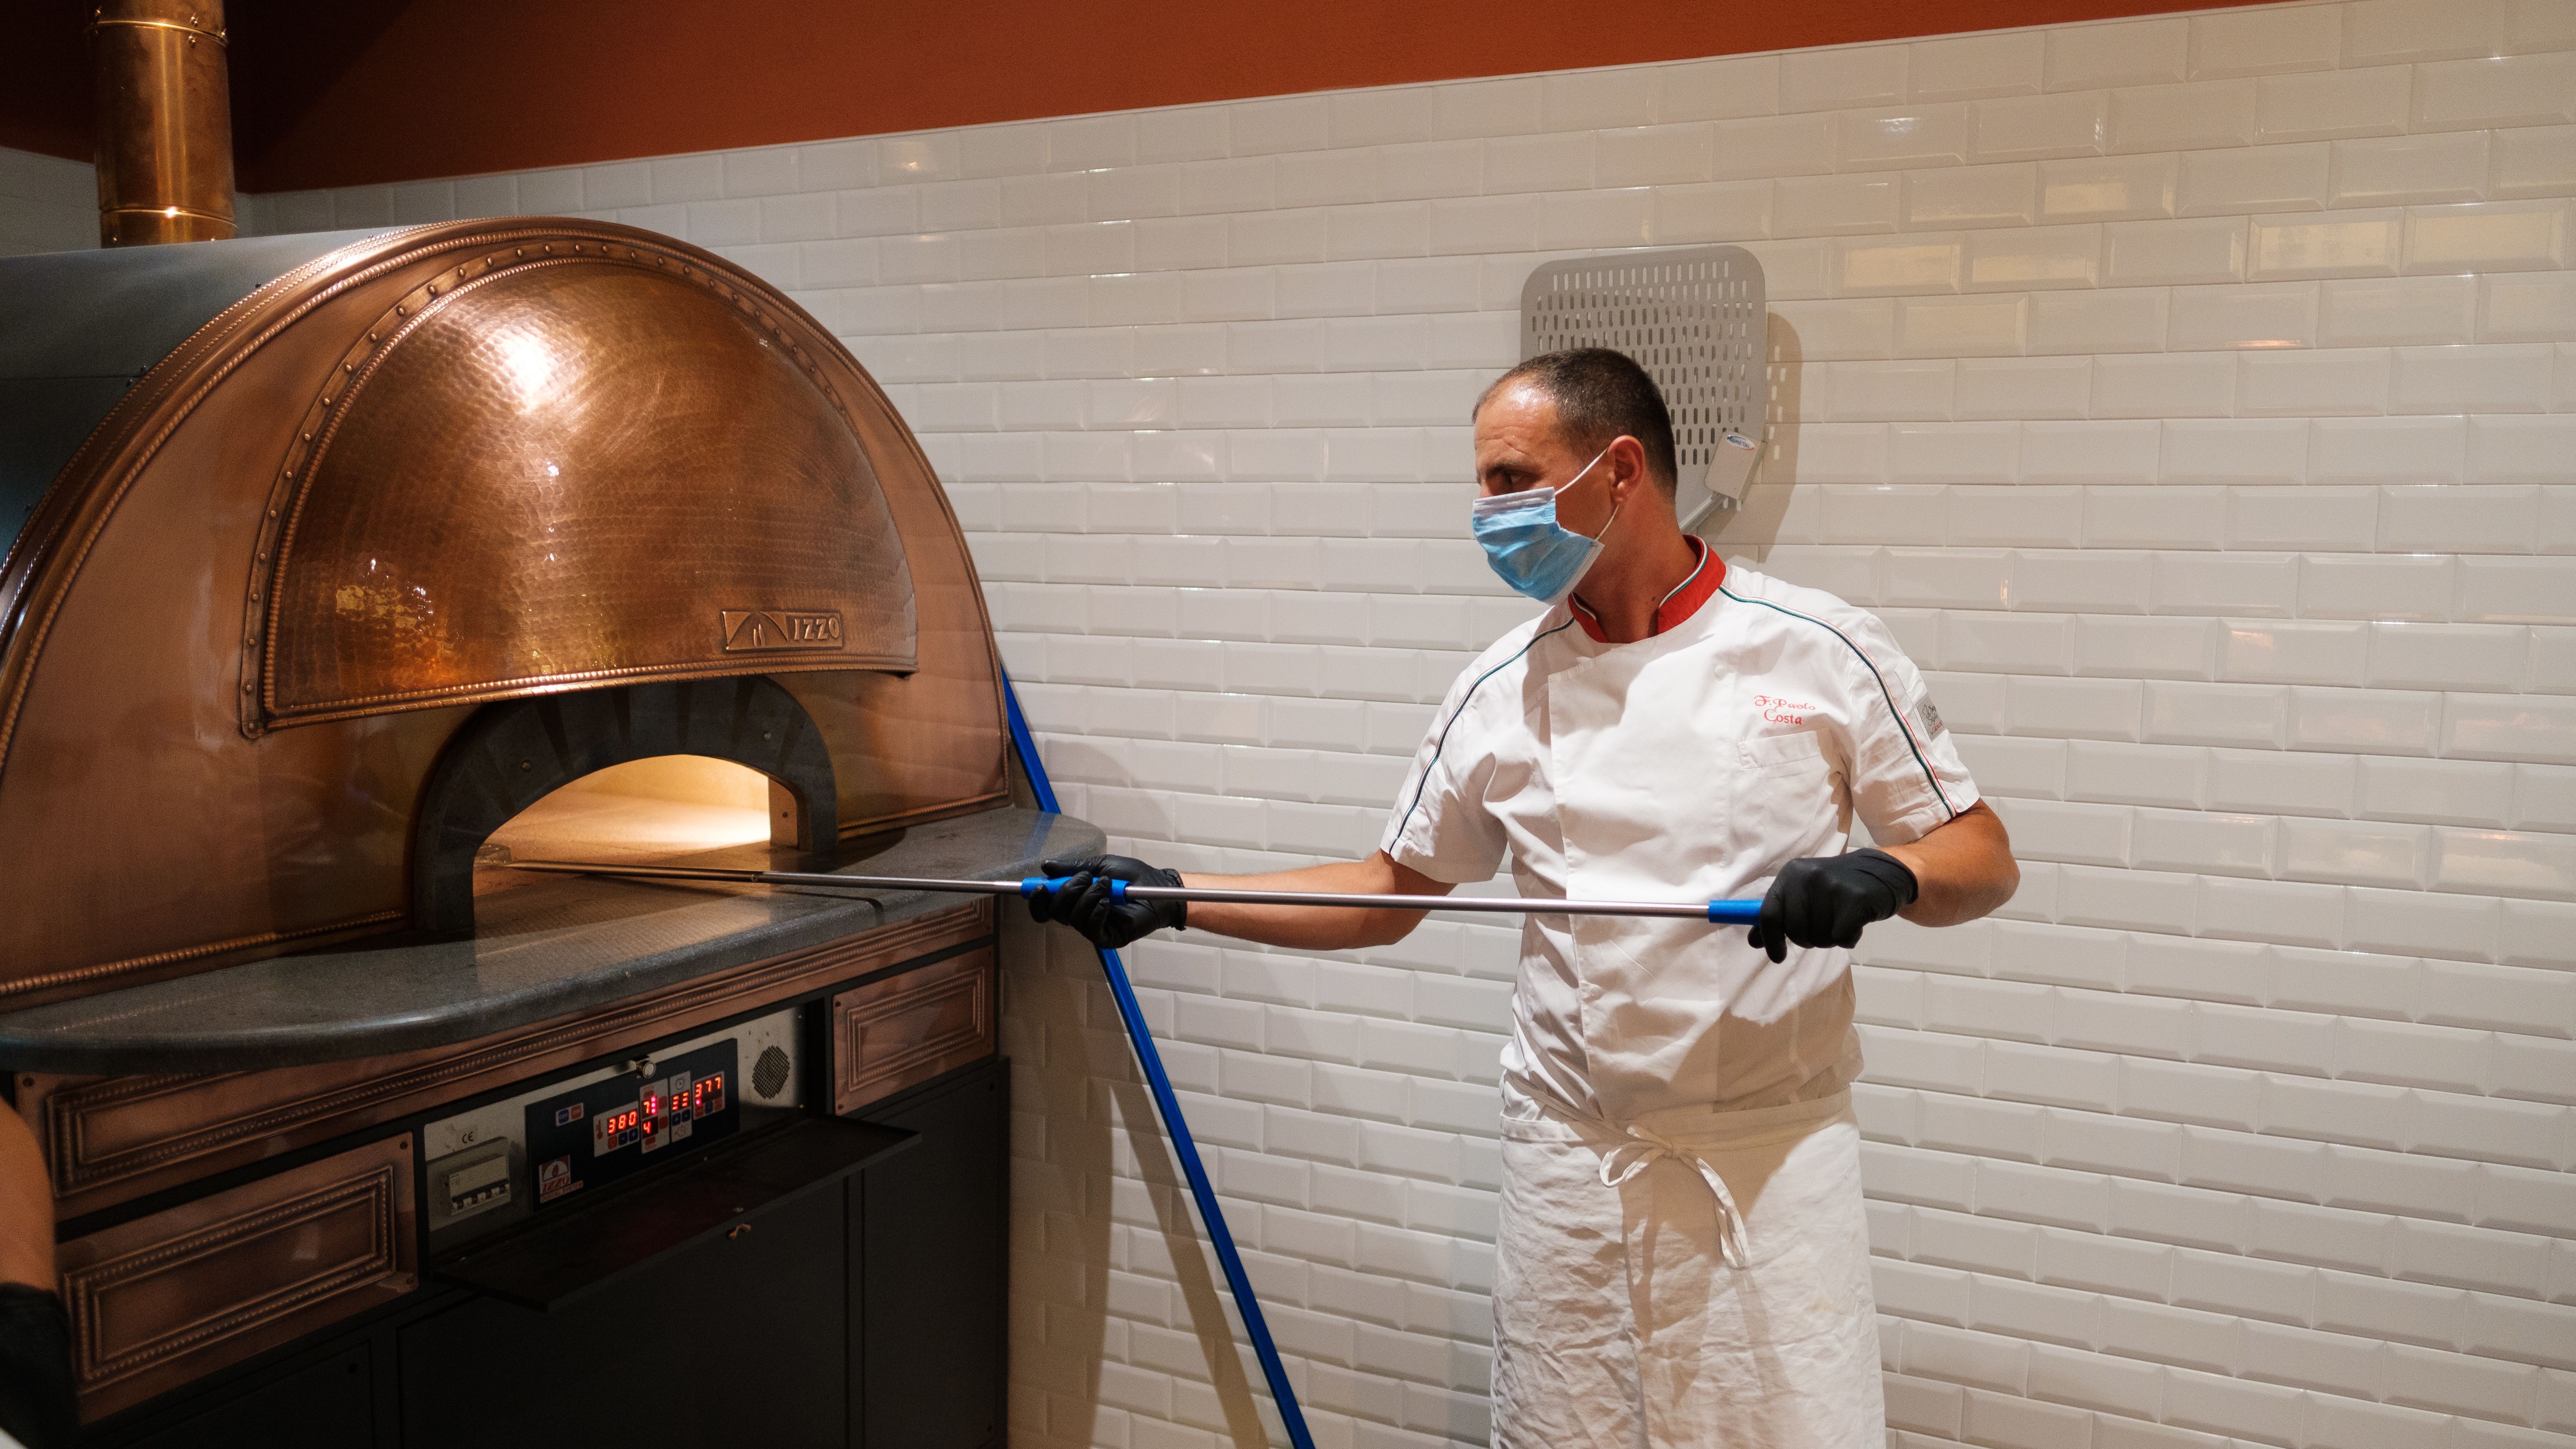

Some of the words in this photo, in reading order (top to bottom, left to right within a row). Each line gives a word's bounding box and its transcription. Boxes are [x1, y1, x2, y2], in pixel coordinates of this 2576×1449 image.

[794, 616, 840, 640] IZZO
[1764, 708, 1803, 724] Costa
[695, 1076, 721, 1098] 377
[608, 1110, 637, 1134] 380
[643, 1121, 651, 1134] 4
[462, 1131, 474, 1144] CE
